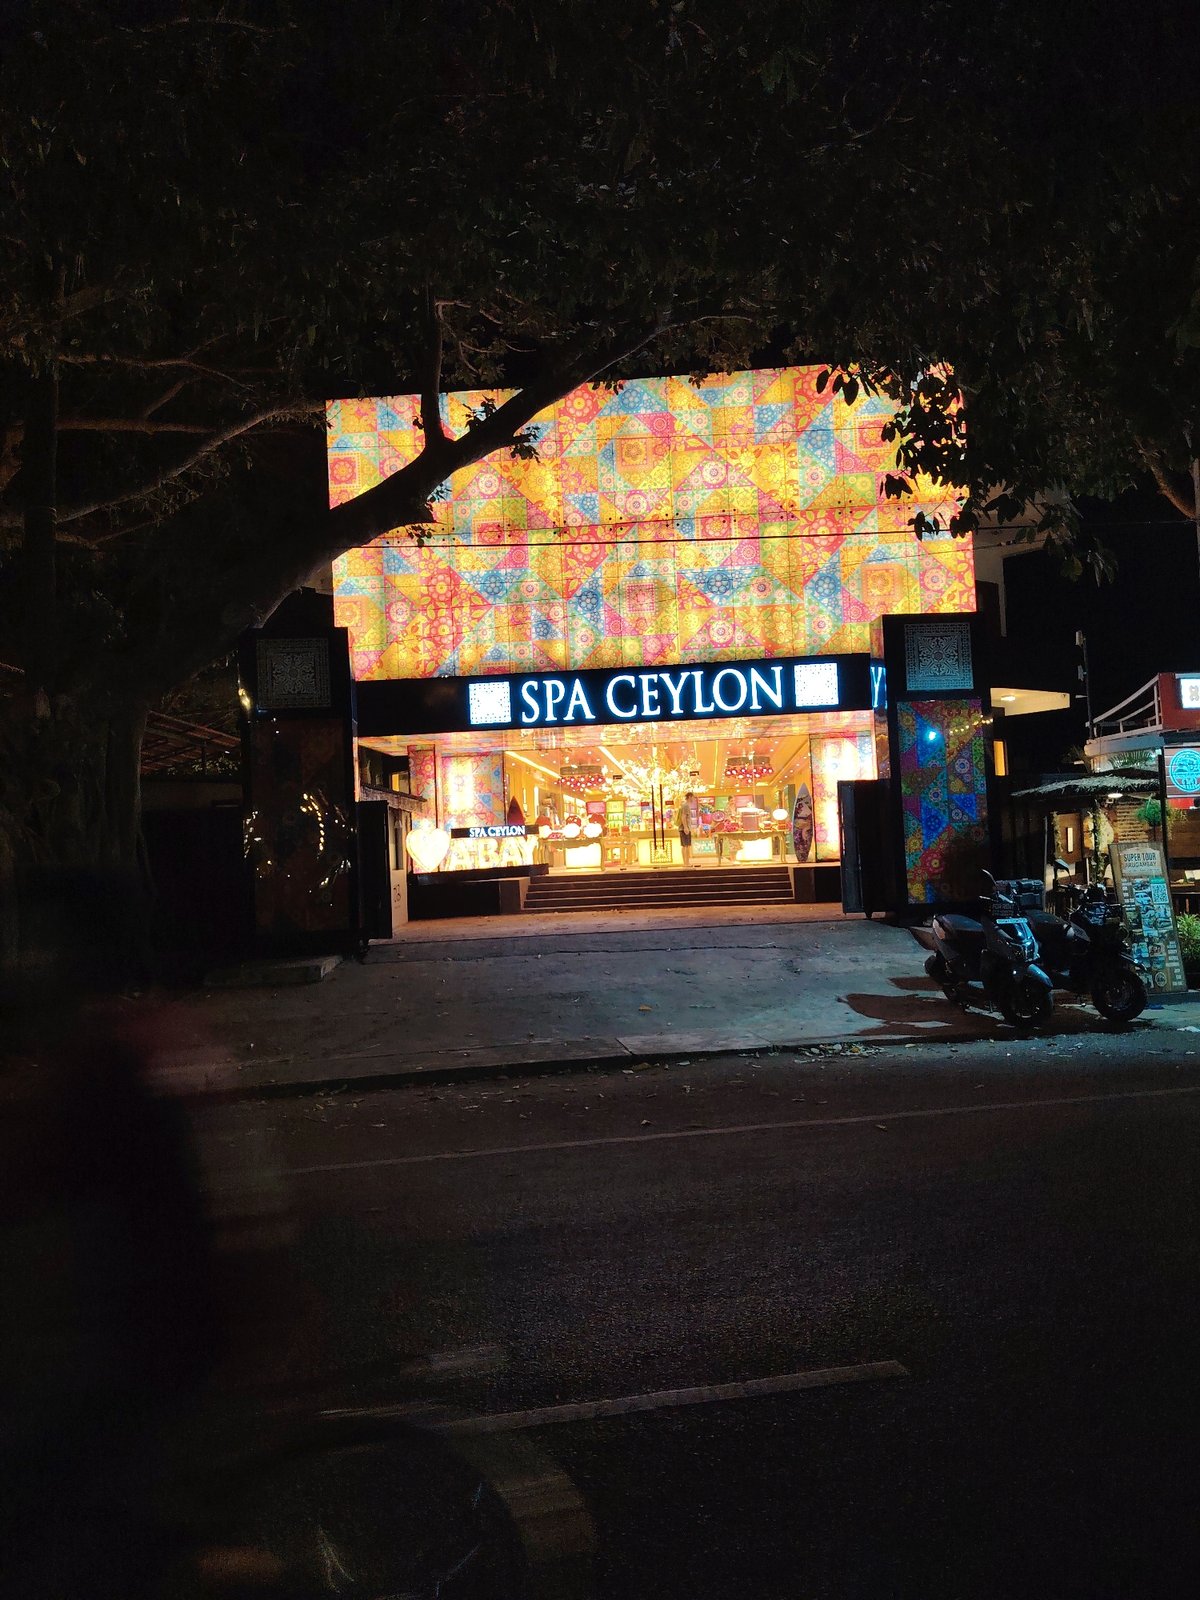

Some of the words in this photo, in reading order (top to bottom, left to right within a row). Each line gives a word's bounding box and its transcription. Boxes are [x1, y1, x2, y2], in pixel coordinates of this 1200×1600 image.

[521, 678, 595, 723] SPA
[606, 666, 783, 718] CEYLON
[469, 826, 486, 837] SPA
[487, 825, 525, 837] CEYLON
[1124, 853, 1141, 862] SUPER
[1142, 852, 1157, 861] TOUR
